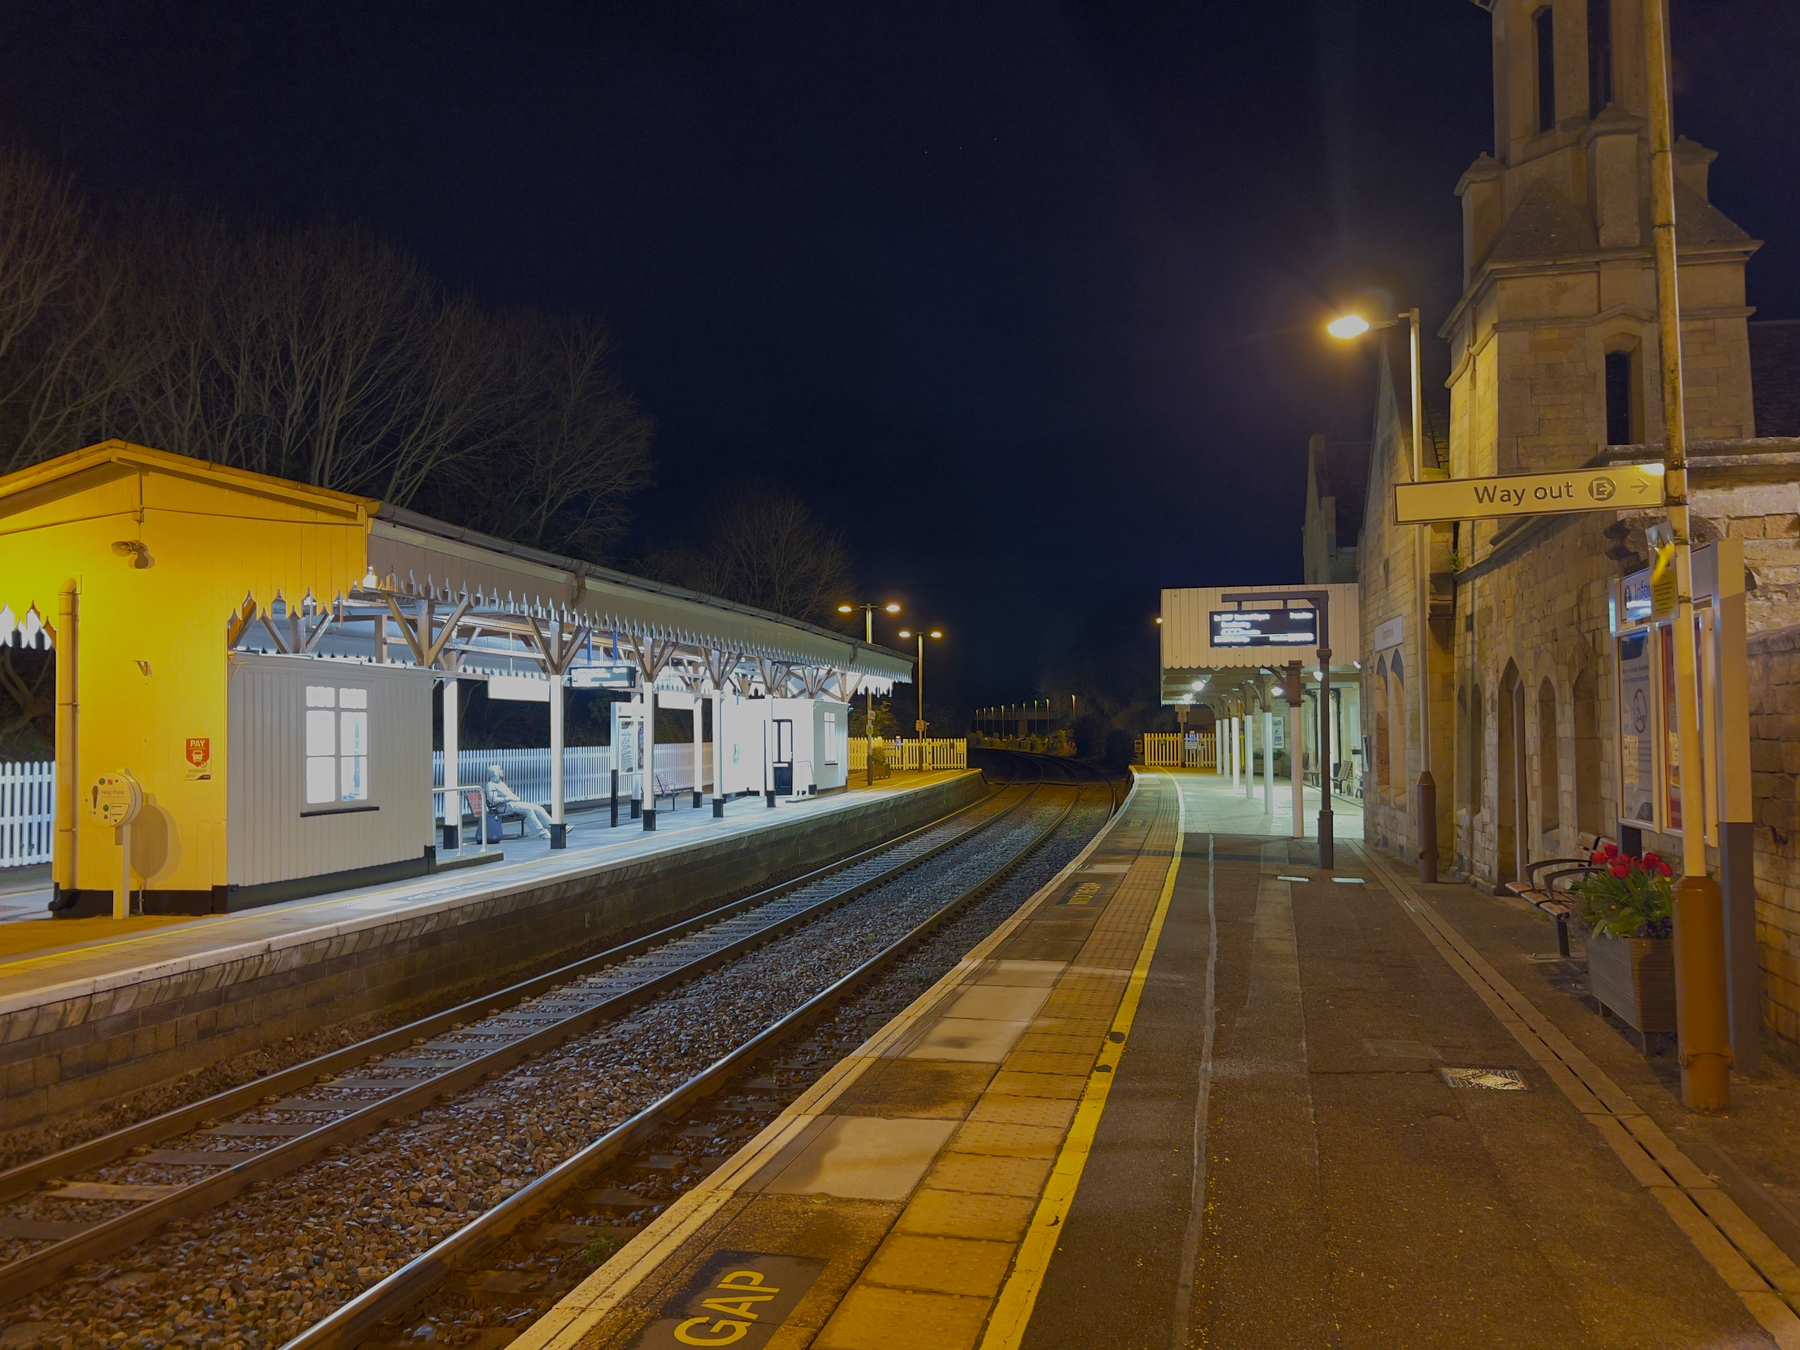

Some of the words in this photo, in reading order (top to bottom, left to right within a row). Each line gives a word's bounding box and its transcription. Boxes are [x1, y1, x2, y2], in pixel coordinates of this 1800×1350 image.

[1473, 485, 1527, 507] Way
[1534, 481, 1575, 500] out
[190, 739, 206, 748] PAY
[673, 1270, 781, 1347] GAP
